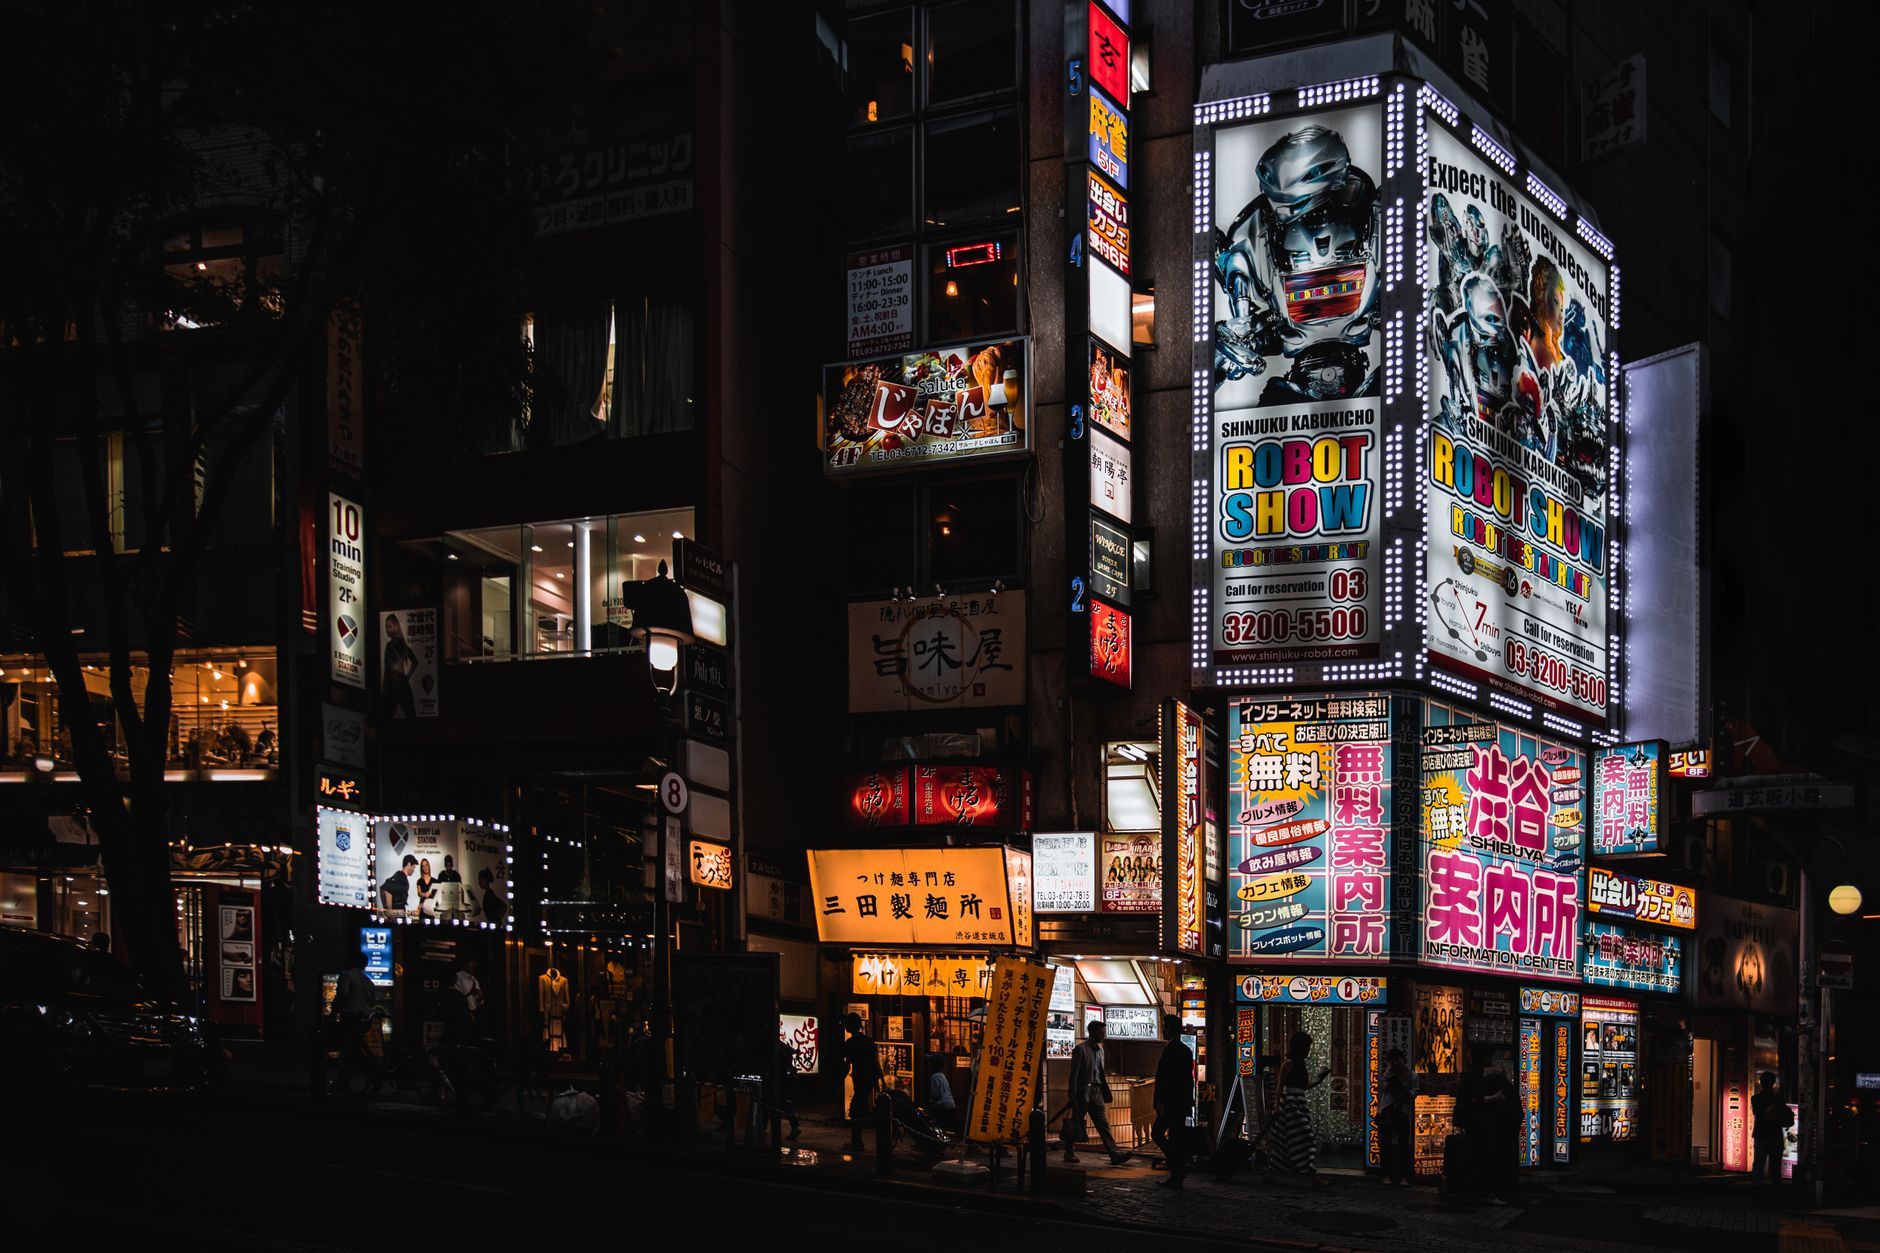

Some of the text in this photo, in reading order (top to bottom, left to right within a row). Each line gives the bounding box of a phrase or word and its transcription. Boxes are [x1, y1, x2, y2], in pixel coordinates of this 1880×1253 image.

[1067, 60, 1082, 95] 5
[1090, 96, 1127, 164] 麻雀
[1098, 148, 1119, 178] 5F
[1090, 179, 1127, 224] 出会い
[1094, 208, 1127, 249] カフェ
[1429, 156, 1605, 322] Expect the unexpected
[1070, 233, 1082, 267] 4
[1090, 229, 1129, 272] 受付6F
[852, 266, 894, 280] ランチ Lunch
[852, 273, 908, 292] 11:00-15:00
[852, 287, 903, 300] ディナー Dinner
[852, 295, 908, 313] 16:00-23:30
[851, 321, 895, 339] AM4:00
[917, 377, 966, 396] Salute
[1071, 405, 1084, 439] 3
[1221, 408, 1374, 438] SHINJUKU KABUKICHO
[831, 447, 863, 467] 4F
[1091, 452, 1128, 485] 朝陽亭
[1226, 434, 1369, 491] ROBOT
[1467, 415, 1581, 502] SHINJUKU KABUKICHO
[1225, 483, 1368, 538] SHOW
[1433, 430, 1604, 571] ROBOT SHOW
[333, 500, 360, 541] 10
[332, 538, 361, 563] min
[1223, 540, 1369, 568] ROBOT RESTAURANT
[1452, 504, 1591, 600] ROBOT RESTAURANT
[332, 558, 361, 579] Training
[332, 569, 355, 584] Studio
[339, 586, 352, 604] 2F
[1072, 577, 1085, 613] 2
[1225, 571, 1367, 600] Call for reservation 03
[1454, 580, 1479, 597] Shinjuku
[407, 610, 434, 623] 次世代
[1225, 608, 1367, 642] 3200-5500
[1475, 601, 1500, 640] 7 min
[872, 629, 1013, 677] 旨味屋
[1480, 641, 1501, 657] Shibuya
[1523, 618, 1595, 663] Call for reservation
[1232, 648, 1358, 662] www.shinjuku-robot.com
[1506, 640, 1605, 707] 03-3200-5500
[1489, 677, 1557, 710] www.shinjuku-robot.com
[1240, 732, 1287, 753] すべて
[1295, 723, 1387, 743] お店選びの決定版!!
[1543, 750, 1568, 762] グルメ情報
[921, 767, 936, 778] 2F
[1248, 752, 1322, 791] 無料
[668, 779, 680, 808] 8
[1423, 788, 1449, 806] すべて
[1466, 743, 1551, 852] 渋谷
[1602, 754, 1625, 847] 案内所
[1628, 770, 1649, 829] 無料
[1186, 725, 1198, 924] 出会いカフェ
[1241, 800, 1298, 824] グルメ情報
[1431, 803, 1468, 840] 無料
[1554, 811, 1581, 823] カフェ情報
[1255, 820, 1326, 846] 優良風俗情報
[1248, 846, 1313, 872] 飲み屋情報
[1333, 744, 1385, 955] 無料案内所
[1470, 836, 1543, 861] SHIBUYA
[856, 871, 956, 887] つけ麺専門店
[1242, 874, 1307, 898] カフェ情報
[1591, 873, 1636, 907] 出会い
[1660, 885, 1671, 895] 6F
[823, 893, 982, 920] 三田製麺所
[1105, 890, 1120, 899] 6F
[1427, 850, 1578, 960] 案内所
[1635, 893, 1672, 920] カフェ
[1240, 903, 1304, 928] タウン情報
[955, 930, 1005, 941] 渋谷道玄坂店
[1251, 929, 1322, 950] プレイスポット情報
[1425, 941, 1576, 972] INFORMATION CENTER
[1600, 933, 1664, 970] 無料案内所
[859, 969, 921, 987] つけ麺
[1261, 977, 1284, 1000] トイレ OK
[1308, 977, 1332, 999] タバコ OK
[1358, 978, 1380, 1000] 充電 OK
[1529, 1032, 1541, 1110] 全て無料
[1555, 1026, 1568, 1138] お気軽にご入場ください
[1581, 1114, 1612, 1137] 出会い
